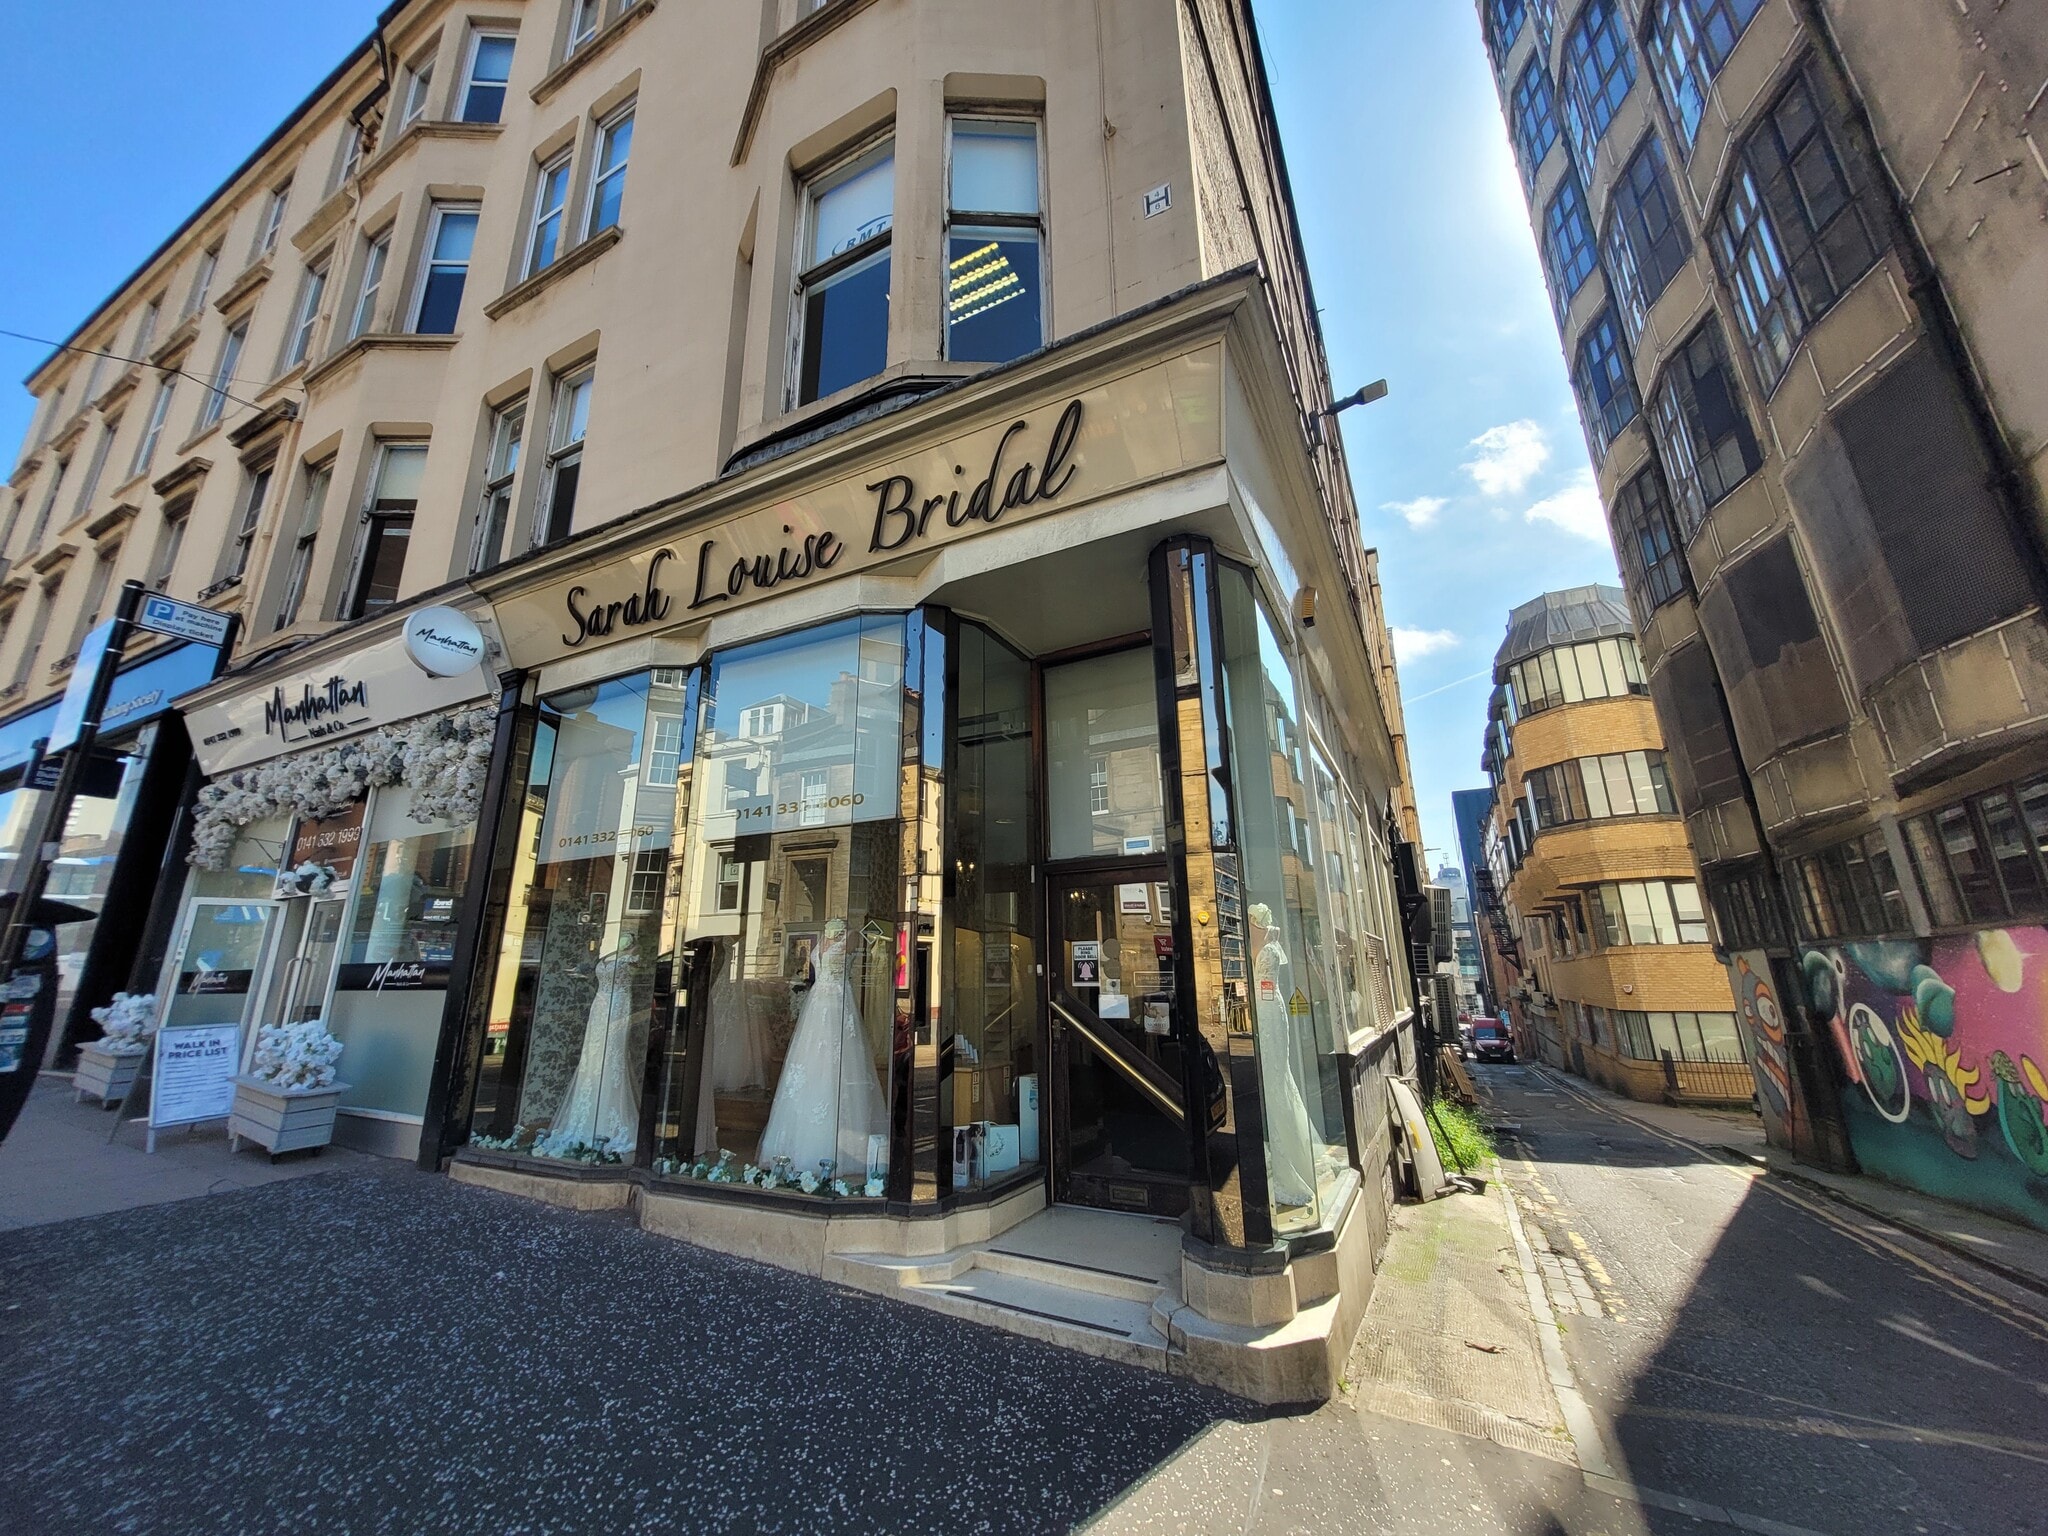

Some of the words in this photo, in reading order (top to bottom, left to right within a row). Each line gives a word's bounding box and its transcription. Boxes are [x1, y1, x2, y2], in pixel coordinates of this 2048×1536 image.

[562, 548, 674, 646] Sarah
[687, 525, 842, 610] Louise
[865, 399, 1082, 553] Bridal
[182, 610, 199, 620] Pay
[200, 616, 220, 625] here
[186, 619, 223, 633] machine
[152, 619, 186, 633] Display
[188, 627, 214, 639] ticket
[415, 628, 478, 654] Manhattan
[265, 675, 367, 743] Manhattan
[296, 835, 317, 852] 0141
[558, 835, 588, 848] 0141
[590, 830, 616, 844] 332
[367, 957, 426, 998] Manhattan
[168, 1050, 201, 1059] PRICE
[204, 1047, 227, 1056] LIST
[174, 1040, 205, 1050] WALK
[209, 1039, 220, 1047] IN
